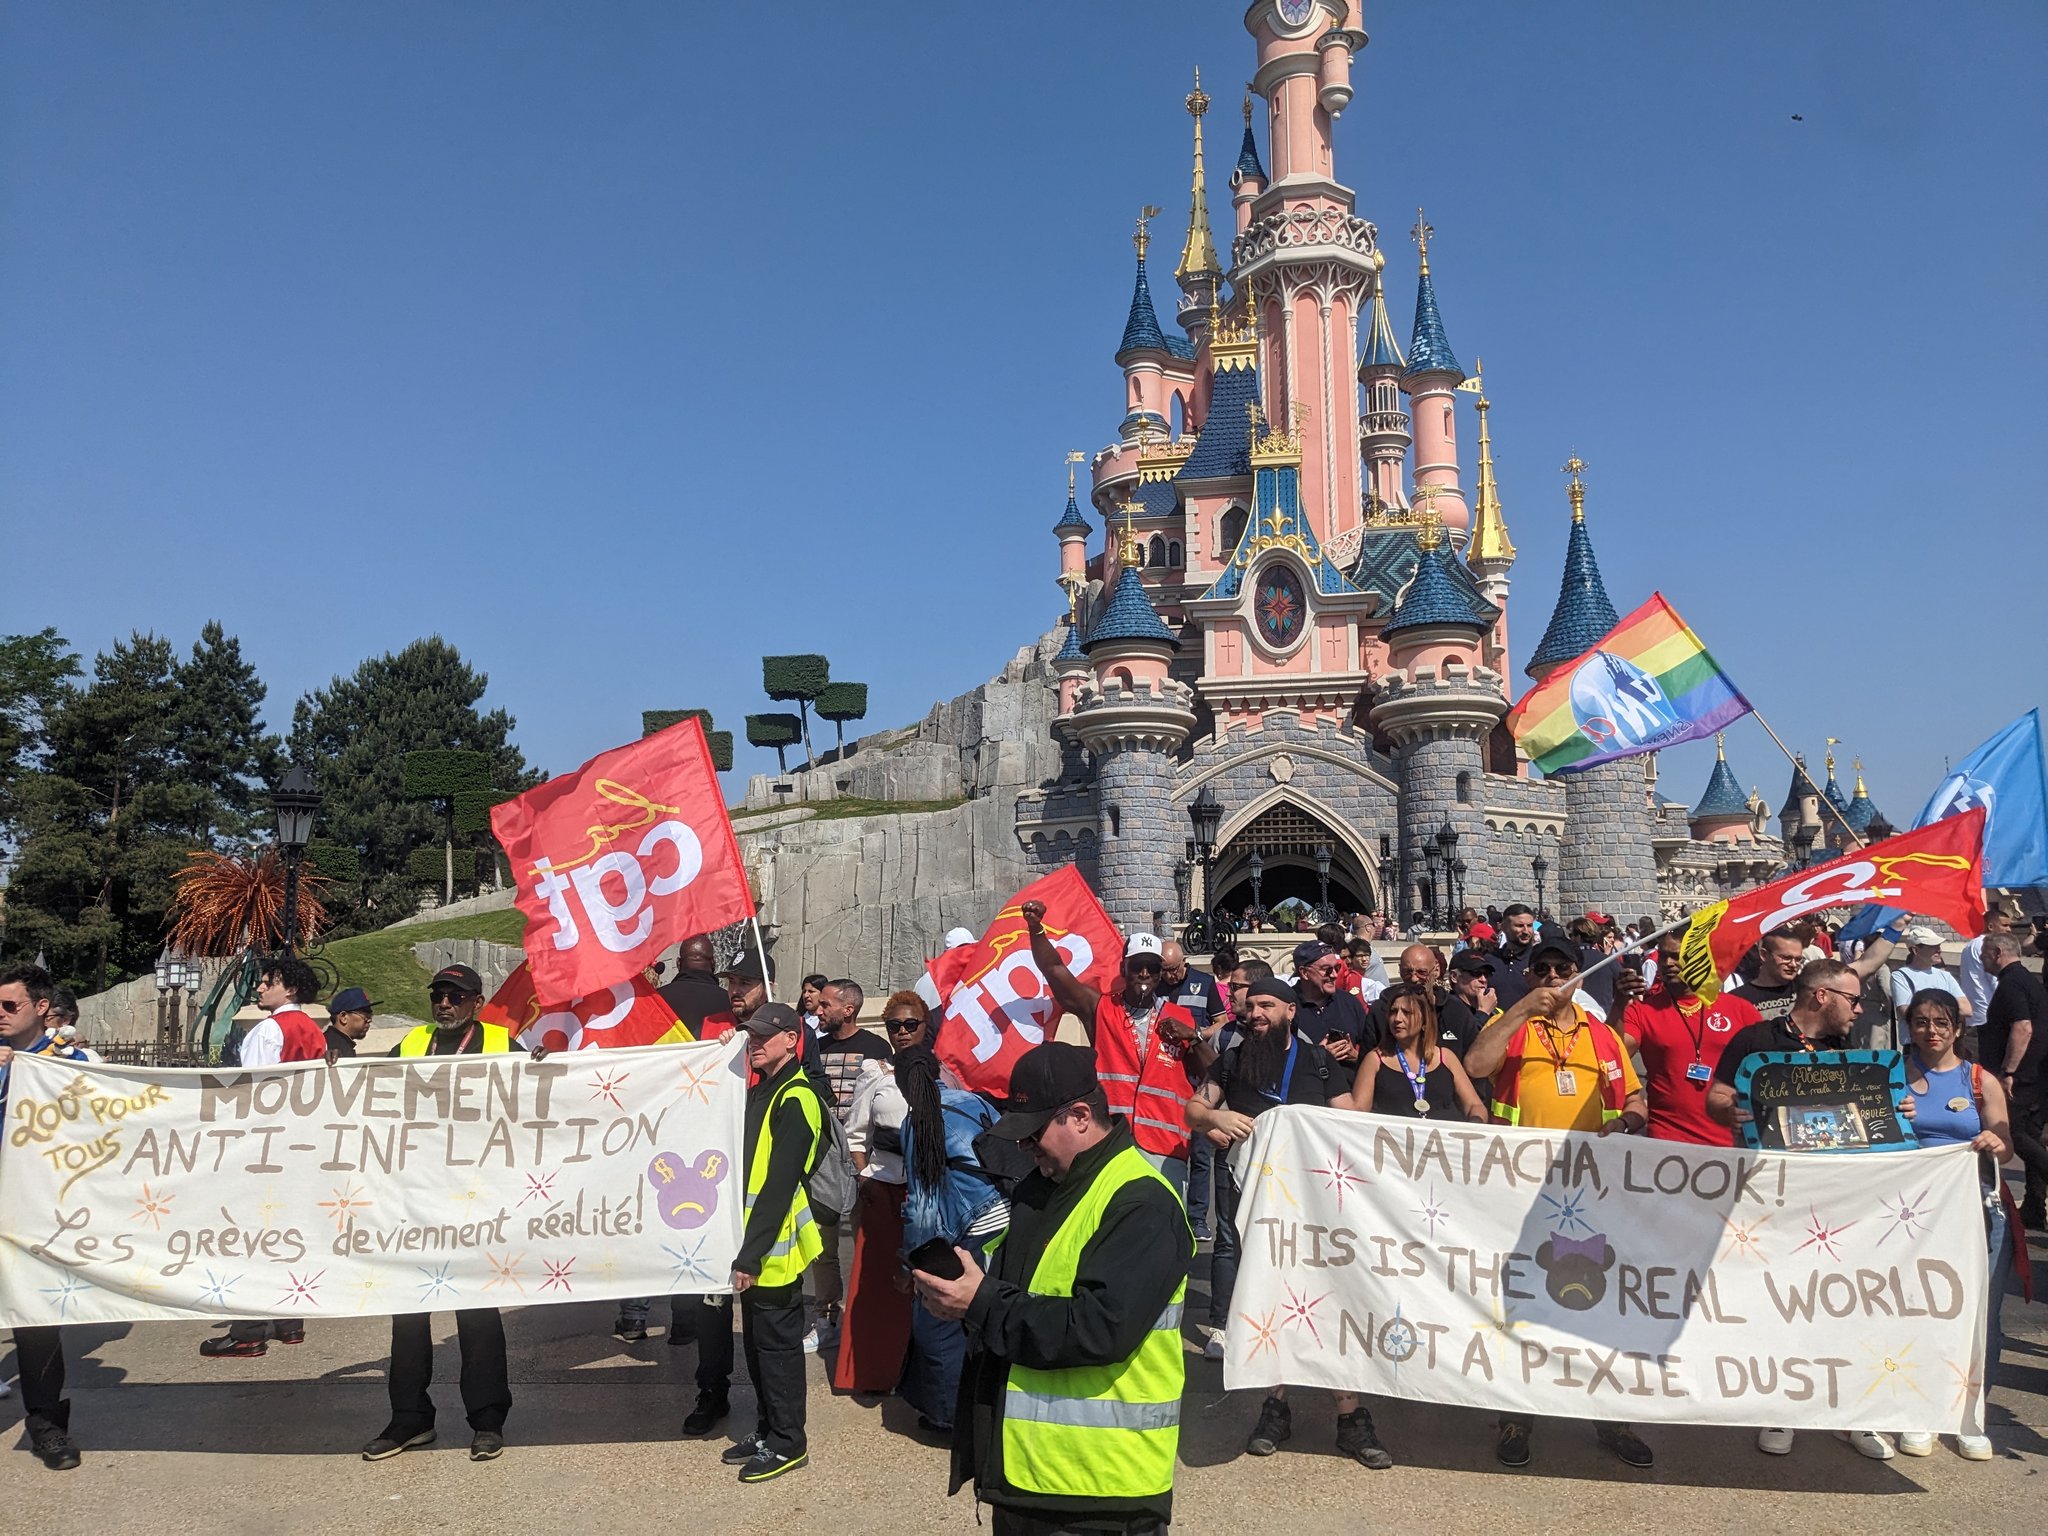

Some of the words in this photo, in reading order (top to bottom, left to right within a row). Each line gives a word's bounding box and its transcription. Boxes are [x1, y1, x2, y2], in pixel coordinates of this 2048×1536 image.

[1141, 936, 1154, 947] NY
[91, 1083, 171, 1125] POUR
[199, 1062, 568, 1122] MOUVEMENT
[1759, 1080, 1789, 1100] Lâche
[1796, 1084, 1806, 1096] la
[1837, 1084, 1846, 1094] si
[1849, 1082, 1861, 1092] tu
[1791, 1066, 1846, 1086] Mickey
[1859, 1094, 1874, 1105] que
[1874, 1094, 1884, 1105] ça
[43, 1128, 124, 1201] TOUS
[122, 1107, 667, 1177] ANTI-INFLATION
[1373, 1126, 1609, 1200] NATACHA,
[1624, 1150, 1787, 1207] LOOK!
[30, 1206, 135, 1267] Les
[332, 1207, 511, 1258] deviennent
[1254, 1217, 1358, 1270] THIS
[1369, 1235, 1426, 1277] IS
[1437, 1246, 1536, 1300] THE
[1618, 1264, 1747, 1323] REAL
[1764, 1258, 1965, 1323] WORLD
[1339, 1309, 1450, 1370] NOT
[1461, 1331, 1493, 1381] A
[1520, 1339, 1690, 1397] PIXIE
[1715, 1356, 1853, 1408] DUST
